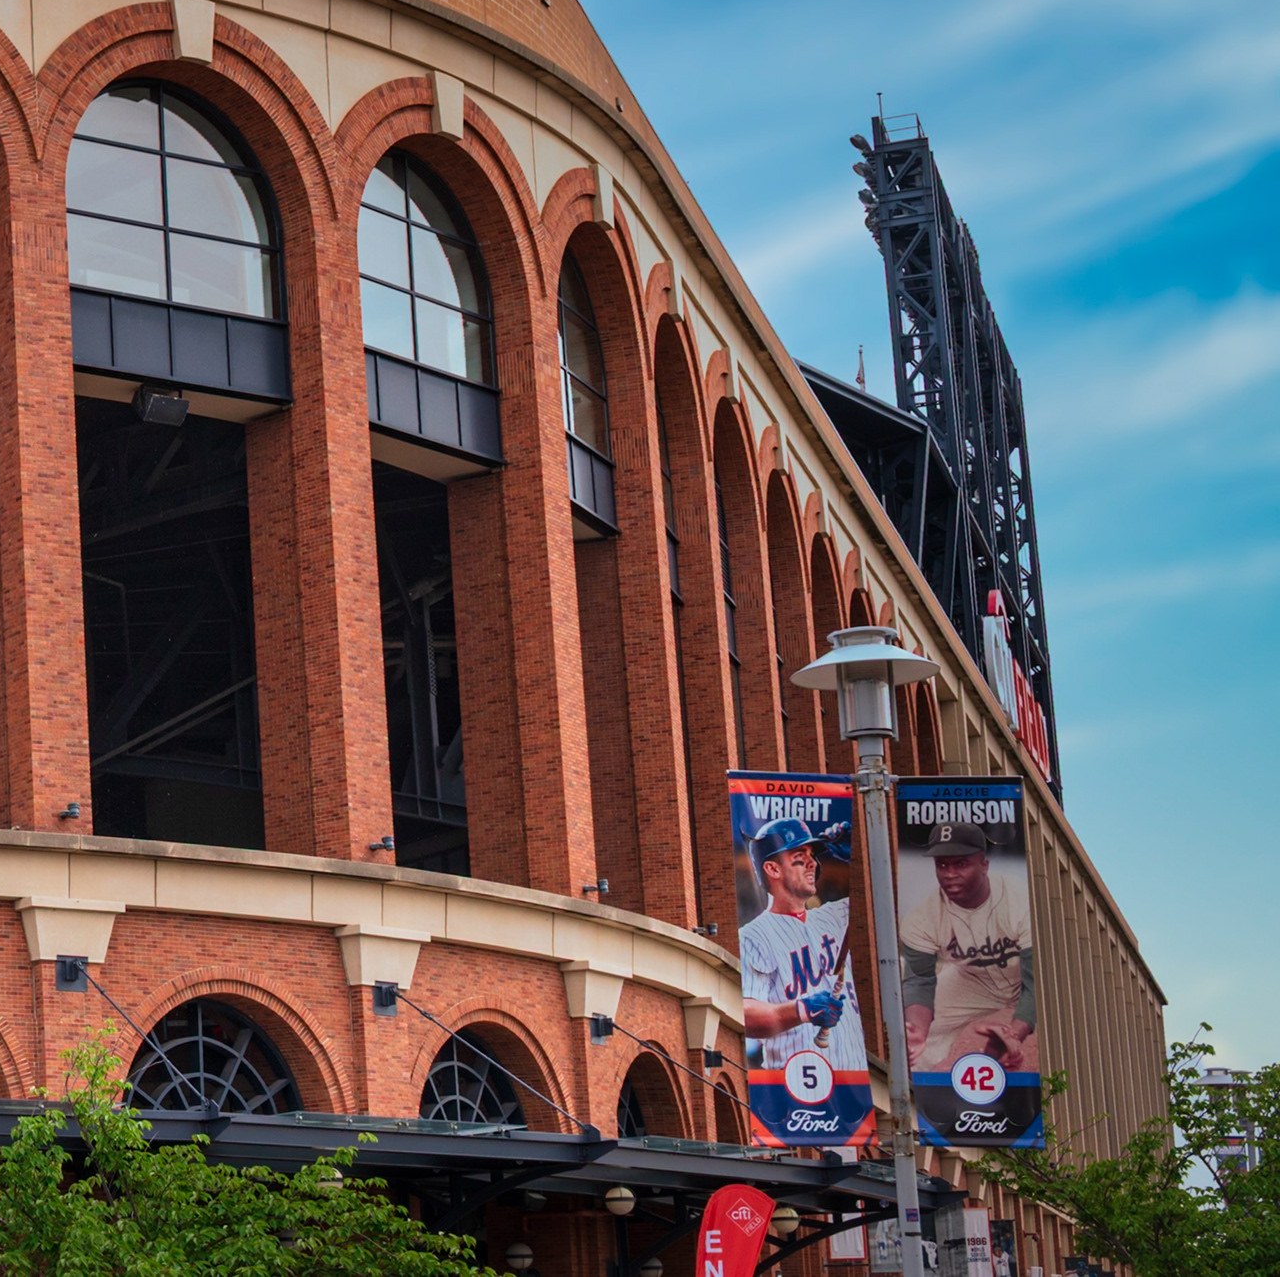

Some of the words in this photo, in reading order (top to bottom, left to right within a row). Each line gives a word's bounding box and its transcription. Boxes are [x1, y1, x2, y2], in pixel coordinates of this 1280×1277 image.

[765, 782, 816, 794] DAVID
[932, 787, 990, 798] JACKIE
[750, 796, 832, 821] WRIGHT
[907, 800, 1016, 825] ROBINSON
[939, 825, 952, 842] B
[802, 1066, 818, 1090] 5
[960, 1066, 996, 1092] 42
[786, 1109, 840, 1133] Ford
[955, 1111, 1007, 1134] Ford
[731, 1207, 751, 1220] citi
[745, 1217, 761, 1233] FIELD
[967, 1237, 988, 1246] 1986
